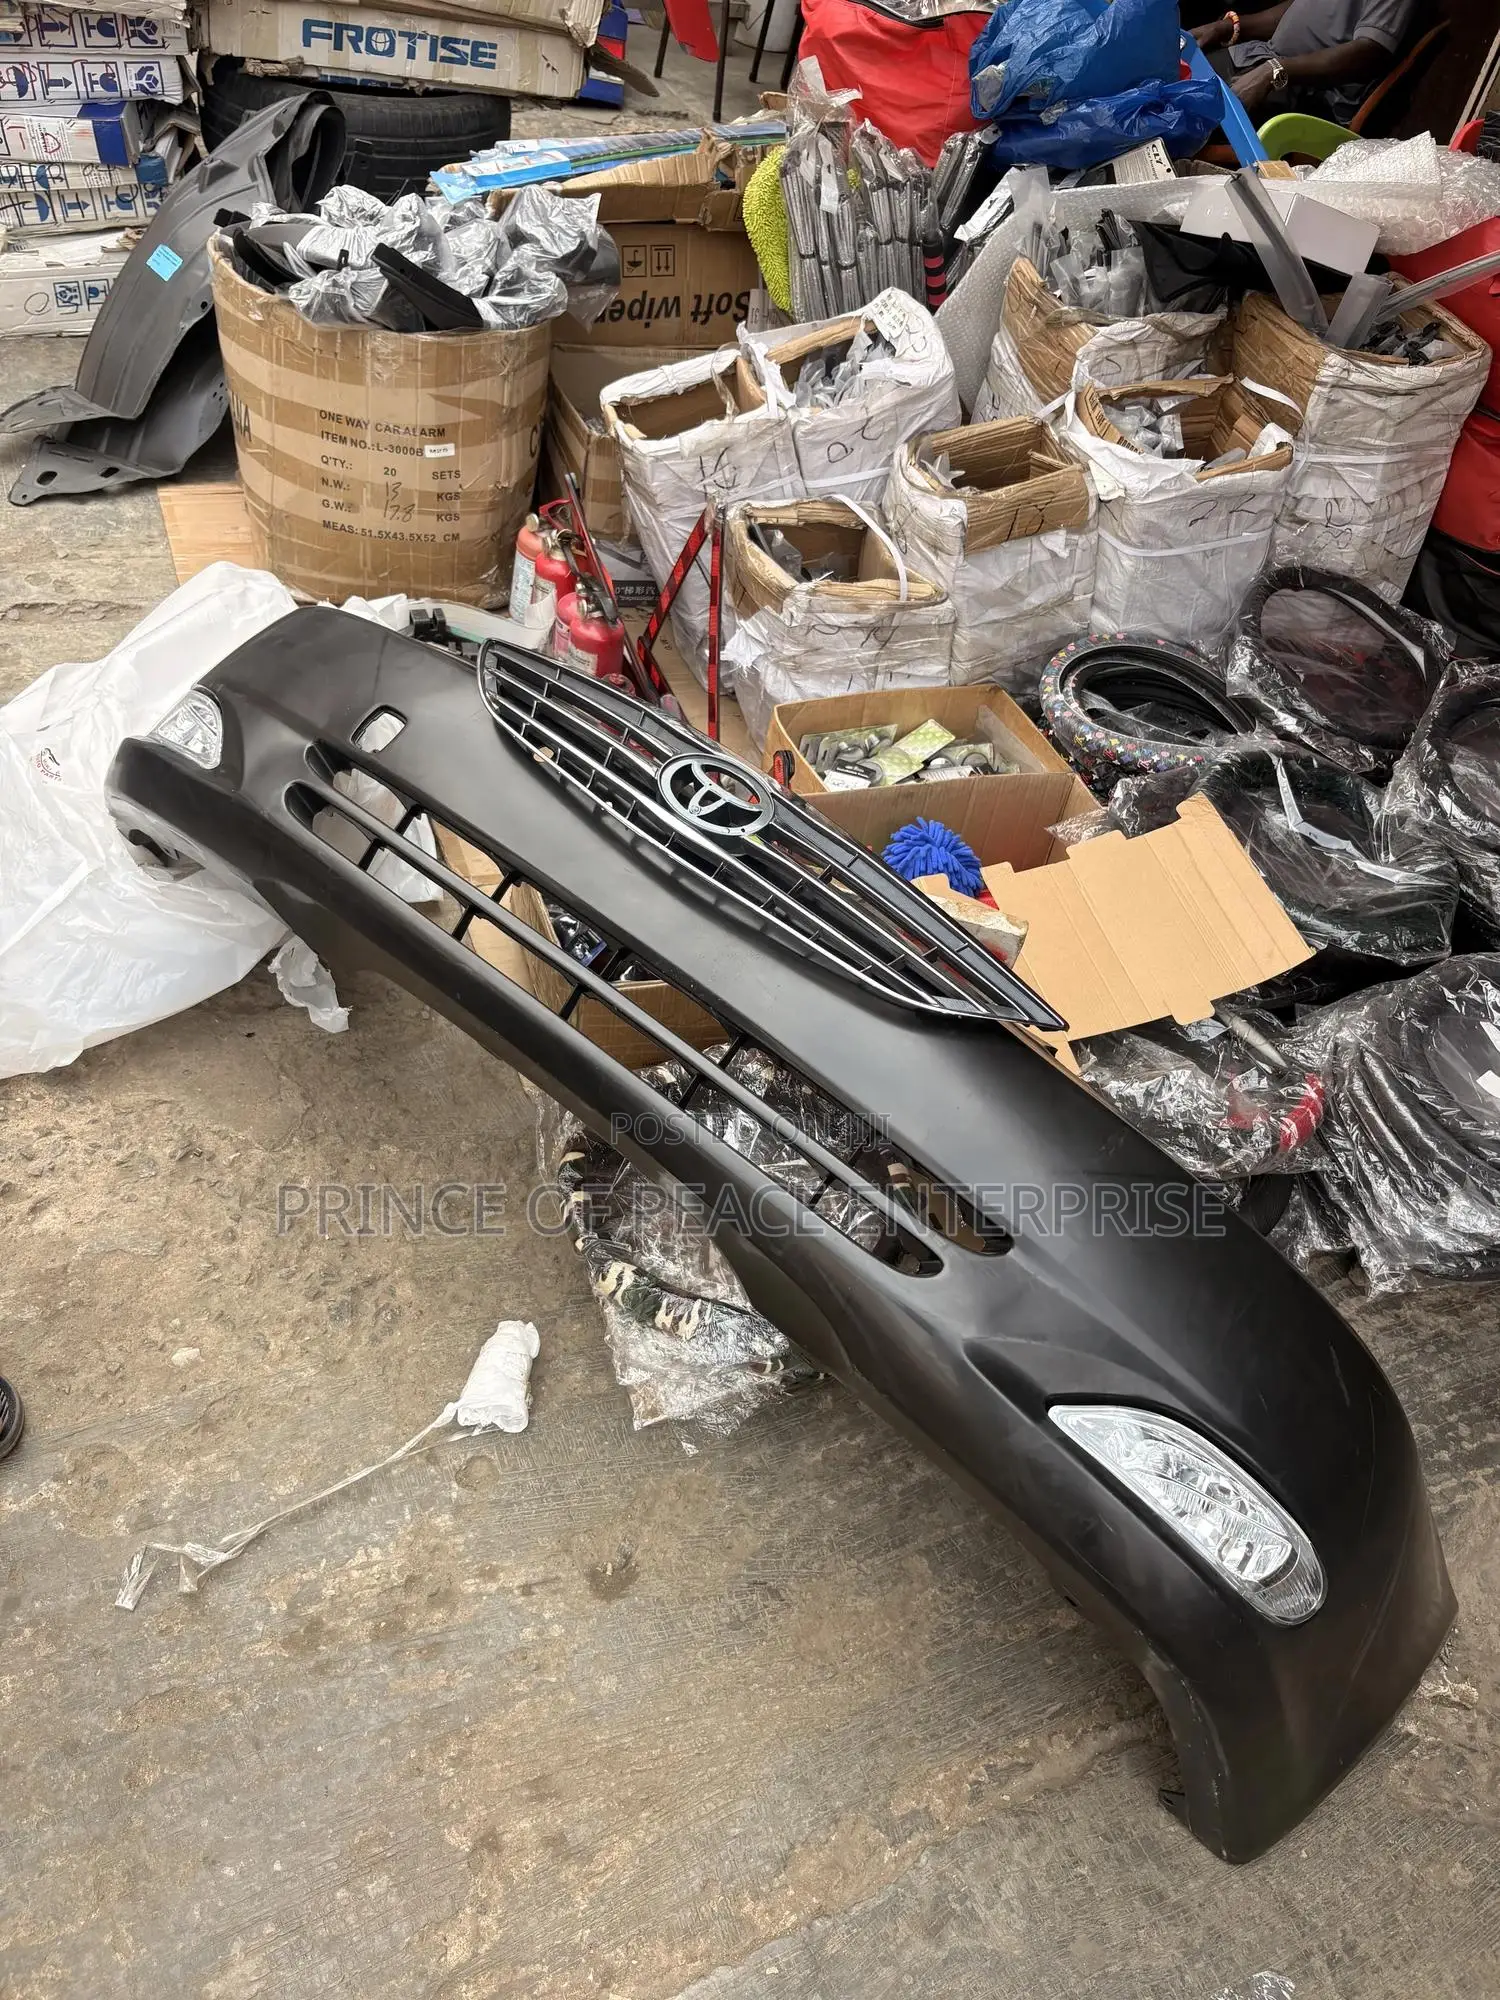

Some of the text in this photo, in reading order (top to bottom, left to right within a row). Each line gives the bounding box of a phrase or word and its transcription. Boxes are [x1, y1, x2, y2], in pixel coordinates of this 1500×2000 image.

[302, 18, 498, 70] FROTISE
[691, 291, 751, 325] Soft
[319, 409, 446, 438] ONE WAY CAR ALARM
[320, 430, 348, 446] ITEM
[383, 466, 397, 477] 20
[431, 470, 461, 480] SETS
[321, 477, 351, 491] N.W.:
[436, 492, 461, 502] KGS
[321, 499, 352, 513] G.W.:
[436, 513, 461, 522] KGS
[322, 519, 460, 543] MEAS: 51.5X43.5X52 CM
